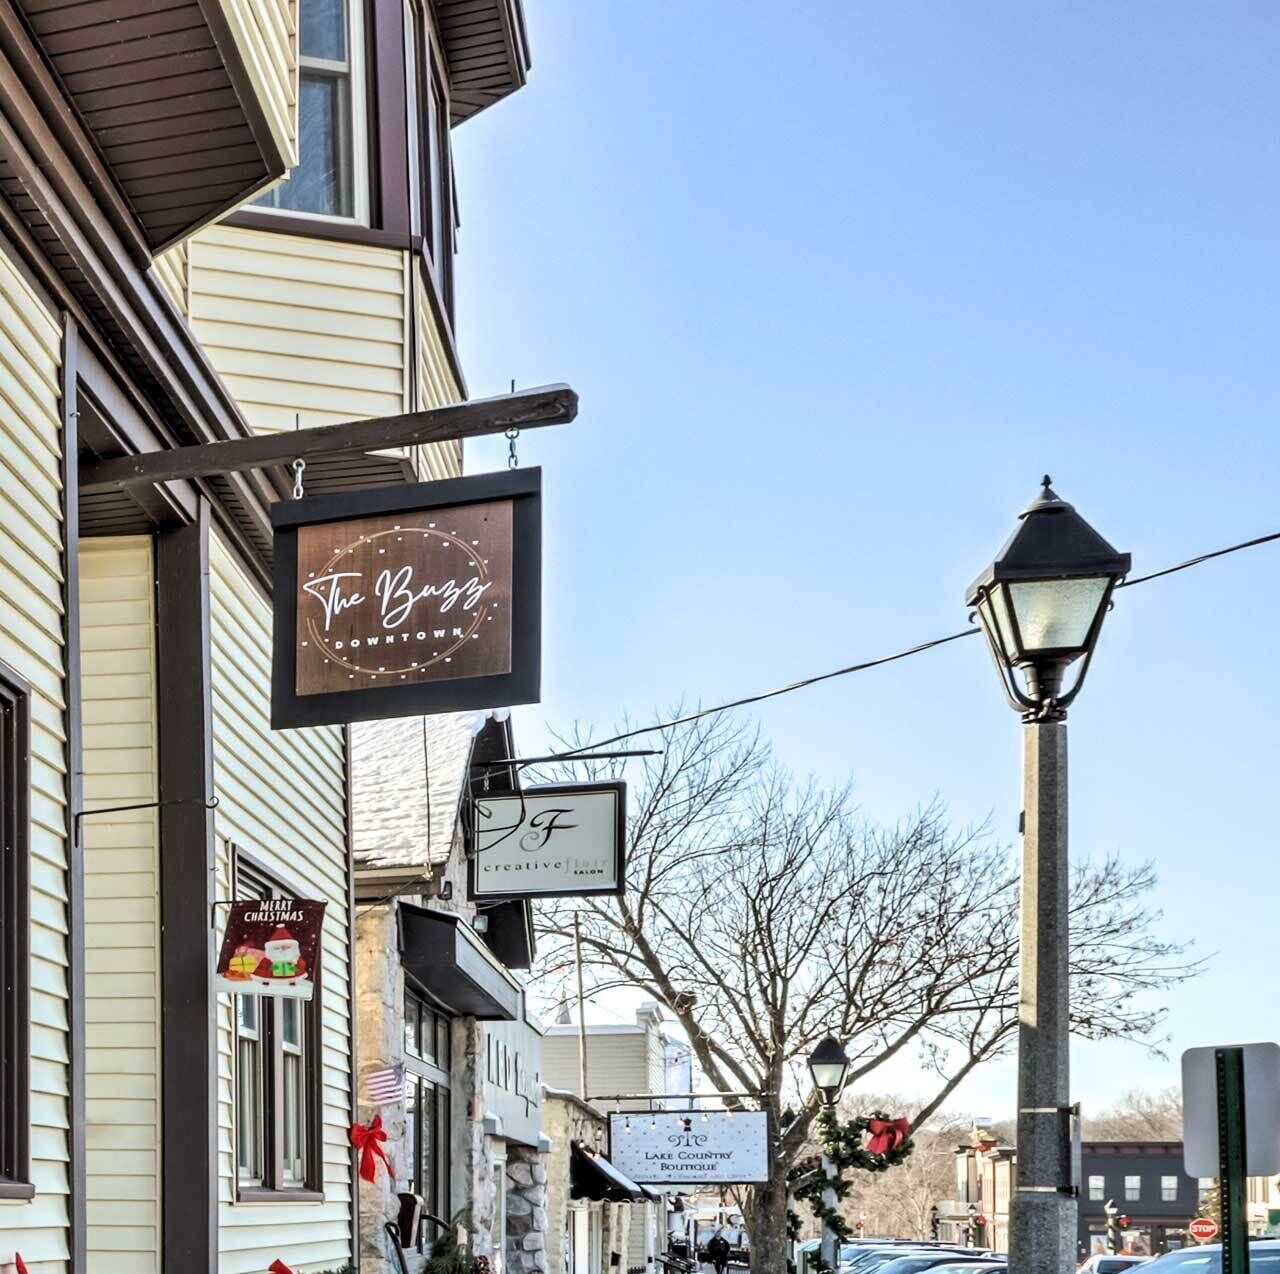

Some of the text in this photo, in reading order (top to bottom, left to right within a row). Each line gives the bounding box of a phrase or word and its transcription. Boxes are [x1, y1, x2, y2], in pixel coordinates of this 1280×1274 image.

[302, 565, 493, 631] The Buzz
[335, 627, 462, 650] DOWNTOWN
[483, 858, 562, 872] creative
[260, 900, 293, 911] MERRY
[244, 910, 304, 922] CHRISTMAS
[645, 1151, 734, 1160] LAKE COUNTRY
[660, 1163, 718, 1172] BOUTIQUE
[1191, 1224, 1216, 1233] STOP
